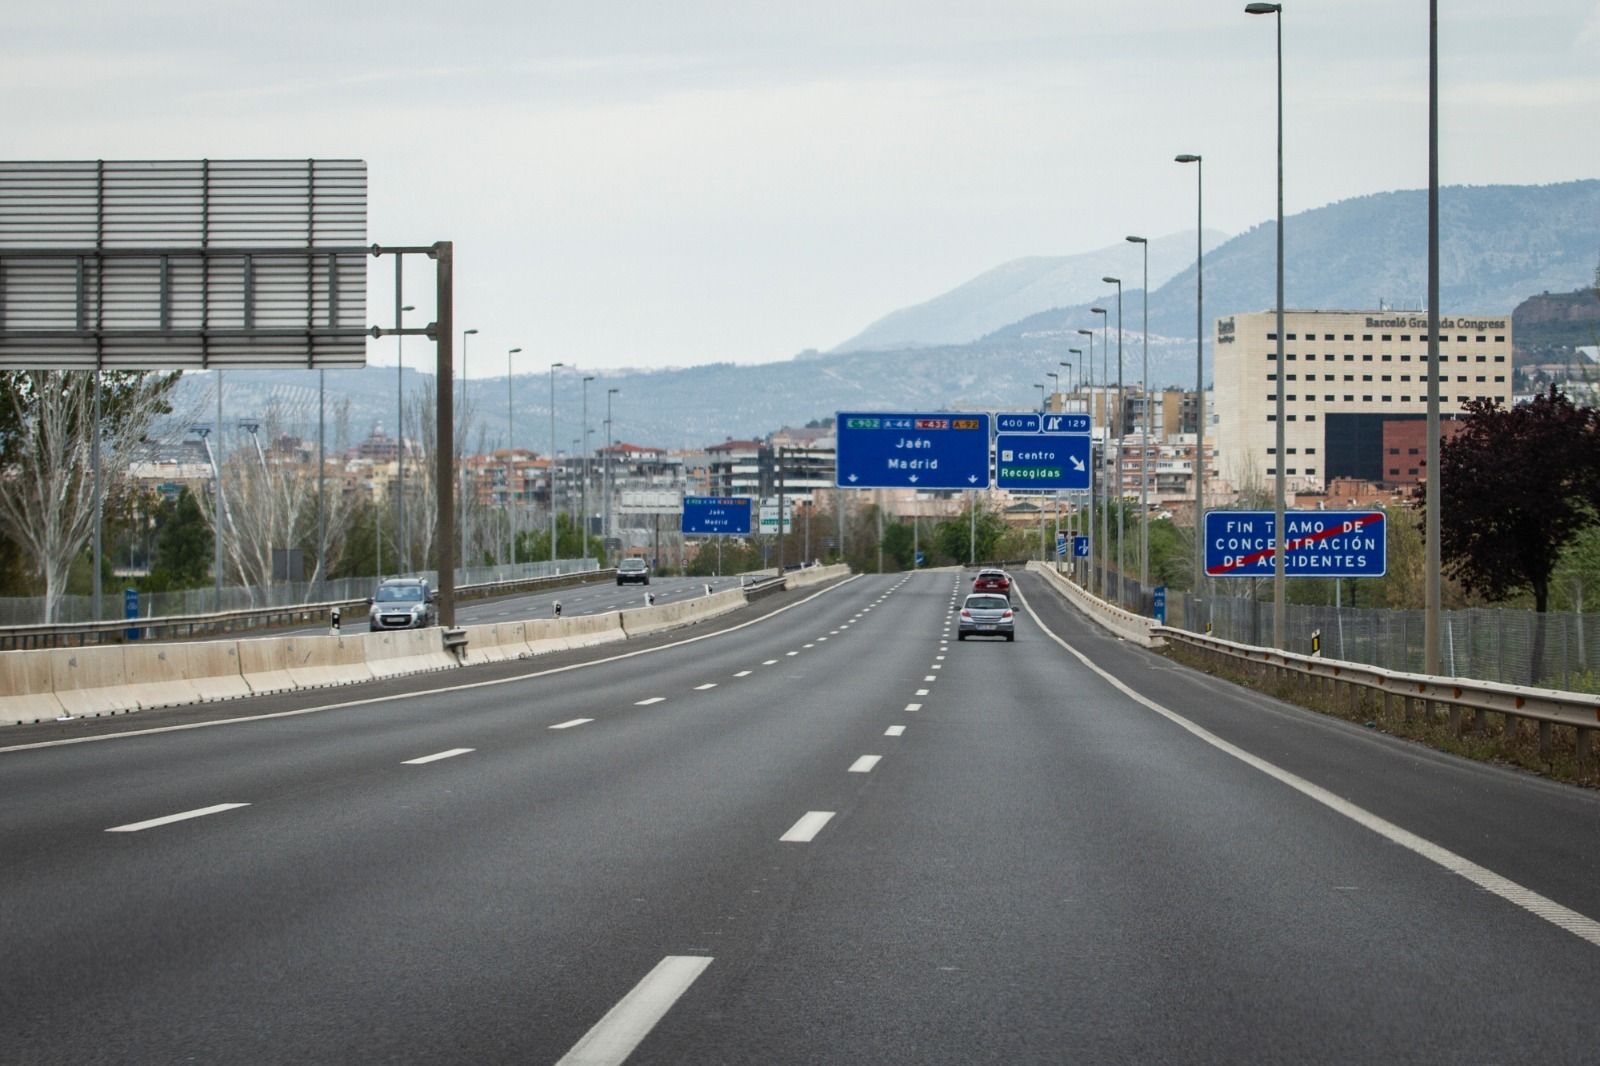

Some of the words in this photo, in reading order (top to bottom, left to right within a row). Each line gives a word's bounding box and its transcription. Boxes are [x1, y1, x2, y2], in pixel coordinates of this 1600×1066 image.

[1365, 316, 1406, 328] Barceló
[1408, 317, 1456, 330] Grada
[1457, 318, 1506, 332] Congress
[1001, 419, 1023, 428] 400
[1027, 420, 1036, 428] m
[1068, 419, 1087, 428] 129
[895, 438, 931, 449] Jaén
[1018, 451, 1055, 460] centro
[888, 458, 938, 470] Madrid
[1001, 468, 1061, 480] Recogidas
[1226, 521, 1253, 533] FIN
[1265, 521, 1325, 533] TAMO
[1342, 521, 1364, 533] DE
[1223, 555, 1246, 568] DE
